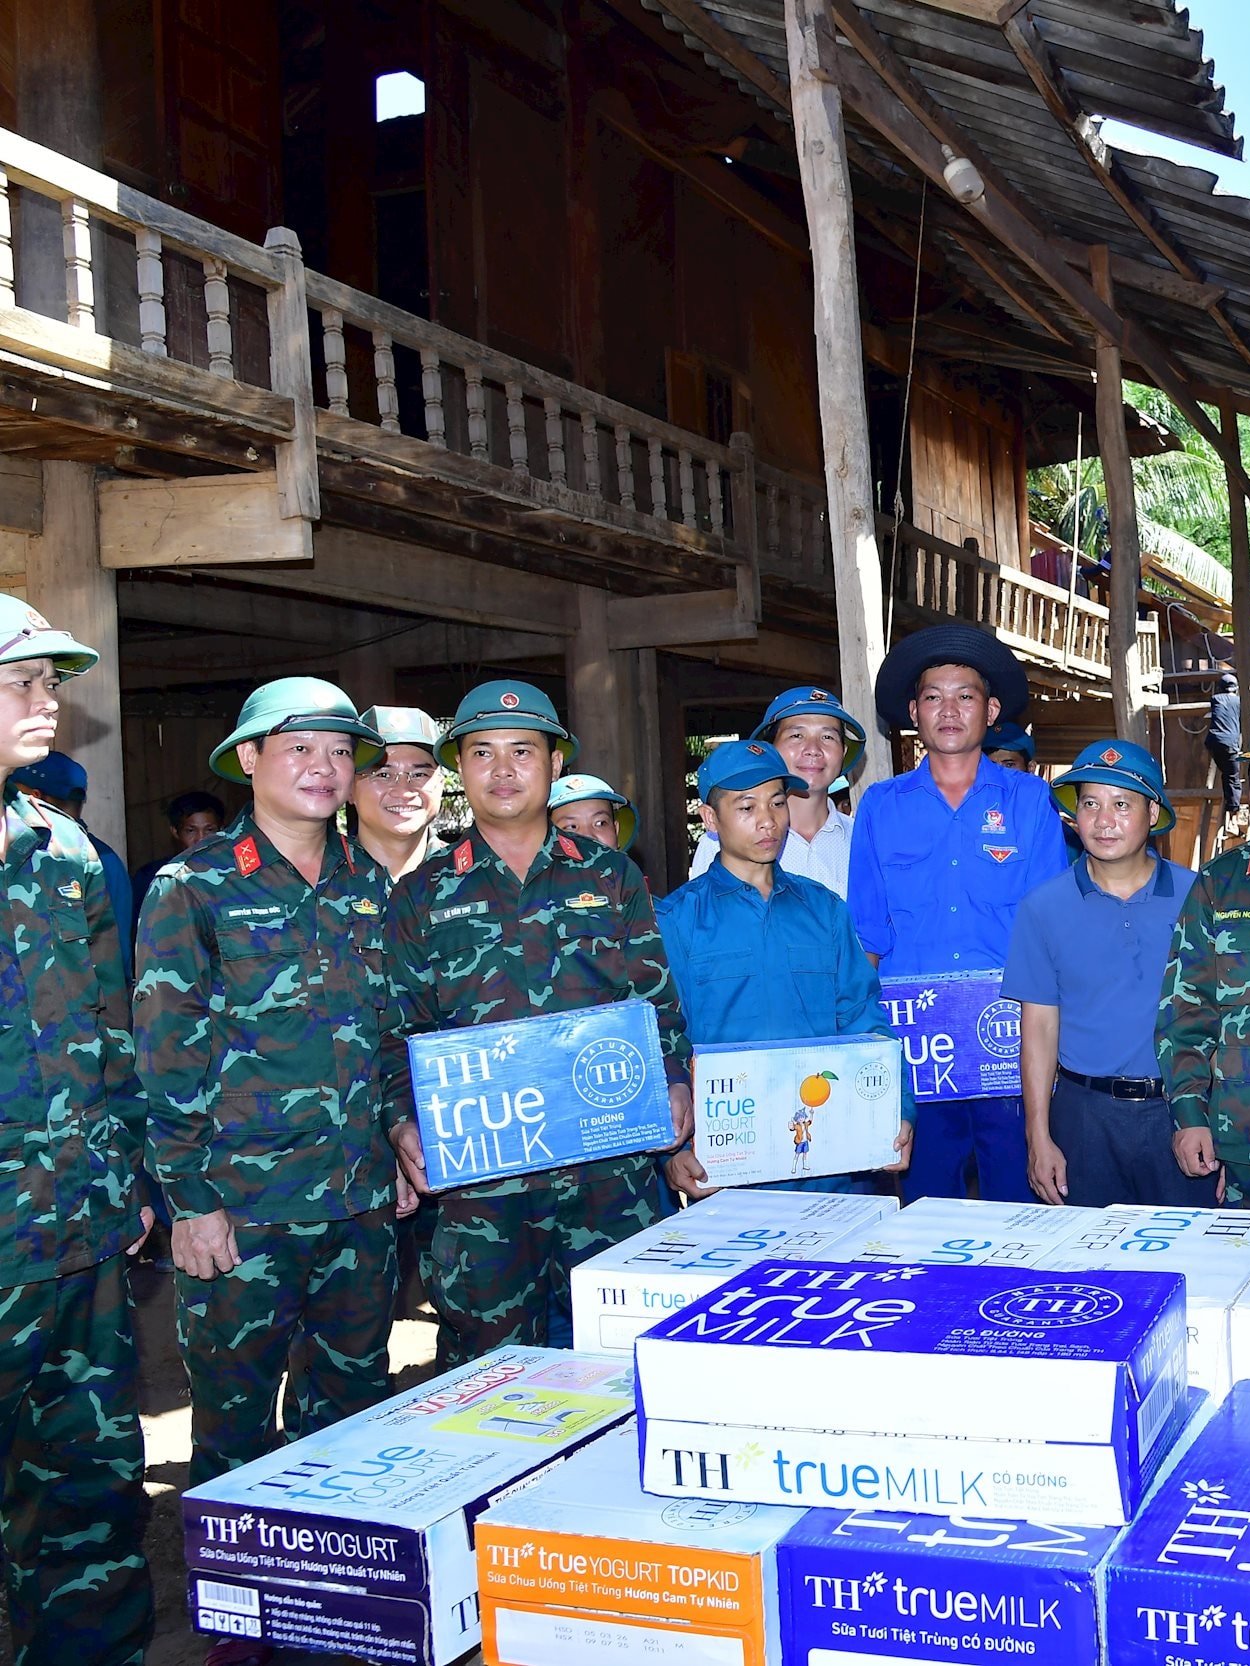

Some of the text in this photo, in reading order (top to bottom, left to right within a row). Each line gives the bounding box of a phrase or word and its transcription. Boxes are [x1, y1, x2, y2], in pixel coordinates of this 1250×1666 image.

[1216, 910, 1242, 918] NGUYỄN
[426, 1048, 494, 1088] TH
[580, 1042, 634, 1064] NATURE
[583, 1074, 640, 1103] GUARANTEED
[589, 1060, 630, 1085] TH
[706, 1078, 734, 1094] TH
[864, 1076, 882, 1087] TH
[912, 1062, 958, 1096] LK
[428, 1087, 545, 1138] true
[705, 1097, 755, 1118] true
[705, 1116, 756, 1132] YOGURT
[708, 1131, 756, 1147] TOPKID
[438, 1122, 554, 1178] MILK
[1070, 1210, 1146, 1250] WATER
[1120, 1211, 1214, 1252] true
[624, 1242, 700, 1264] TH
[671, 1229, 786, 1269] true
[918, 1239, 992, 1264] ue
[978, 1242, 1041, 1266] TER
[758, 1268, 874, 1290] TH
[1010, 1286, 1111, 1302] NATURE
[598, 1288, 627, 1306] TH
[708, 1287, 916, 1322] true
[1015, 1298, 1094, 1314] TH
[666, 1313, 894, 1348] MILK
[989, 1309, 1104, 1326] GUARANTEED
[246, 1460, 338, 1492] TH
[284, 1446, 426, 1500] true
[333, 1448, 458, 1505] YOGURT
[663, 1448, 733, 1490] TH
[201, 1516, 240, 1544] TH
[200, 1547, 214, 1559] Sữa
[216, 1550, 236, 1562] Chua
[260, 1555, 276, 1567] Tiệt
[300, 1560, 328, 1575] Hương
[329, 1562, 346, 1576] Việt
[368, 1568, 380, 1581] Tự
[380, 1569, 406, 1582] Nhiên
[487, 1544, 520, 1568] TH
[668, 1566, 740, 1592] TOPKID
[488, 1572, 740, 1610] Sữa Chua Uống Tiệt Trùng Hương Cam Tự Nhiên
[805, 1575, 862, 1612] TH
[832, 1622, 1036, 1654] Sữa Tươi Tiệt Trùng CÓ ĐƯỜNG
[1137, 1607, 1199, 1646] TH
